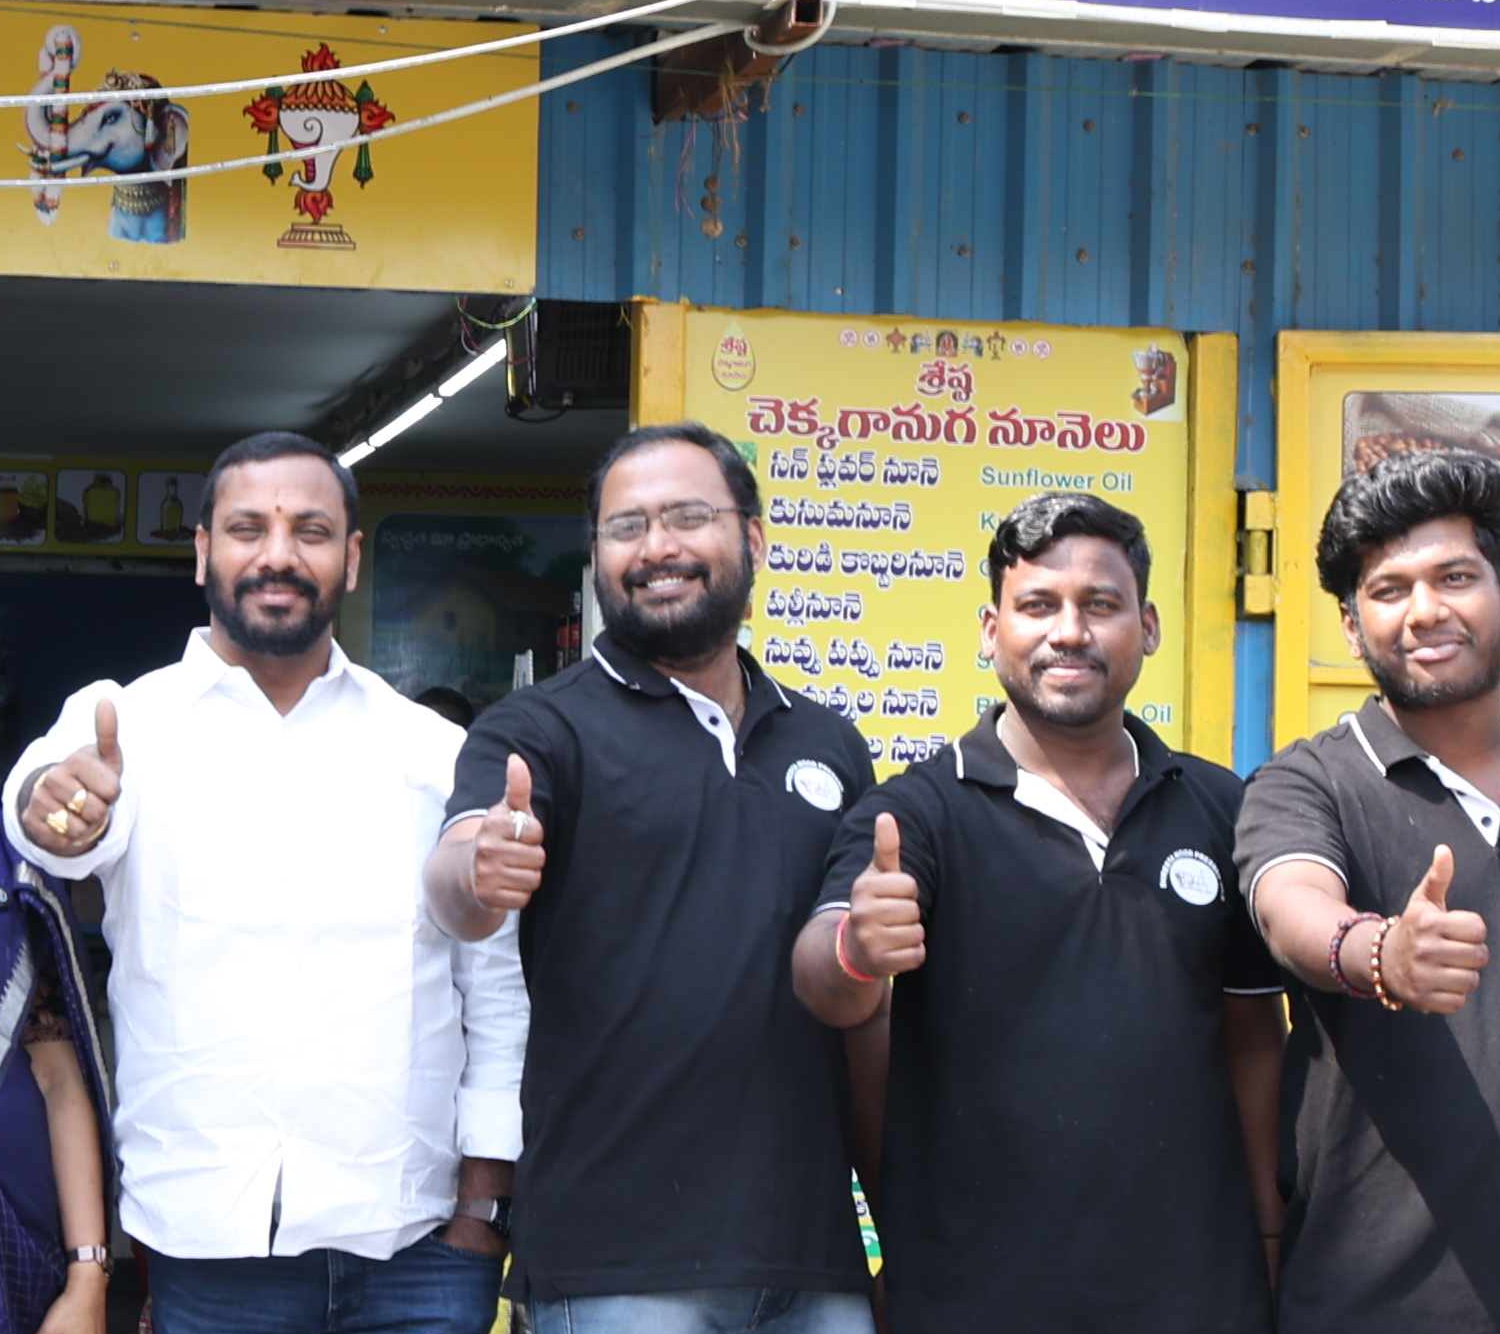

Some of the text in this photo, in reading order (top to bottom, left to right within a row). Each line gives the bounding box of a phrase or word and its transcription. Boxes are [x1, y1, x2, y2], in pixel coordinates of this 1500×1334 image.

[748, 396, 1147, 452] చెక్కగానుగ నూనెలు
[770, 448, 808, 482] సన్
[883, 457, 939, 486] నూనె
[981, 466, 1132, 492] Sunflower Oil
[888, 643, 943, 670] నూనె
[882, 688, 938, 716] నూనె
[1141, 705, 1171, 723] Oil
